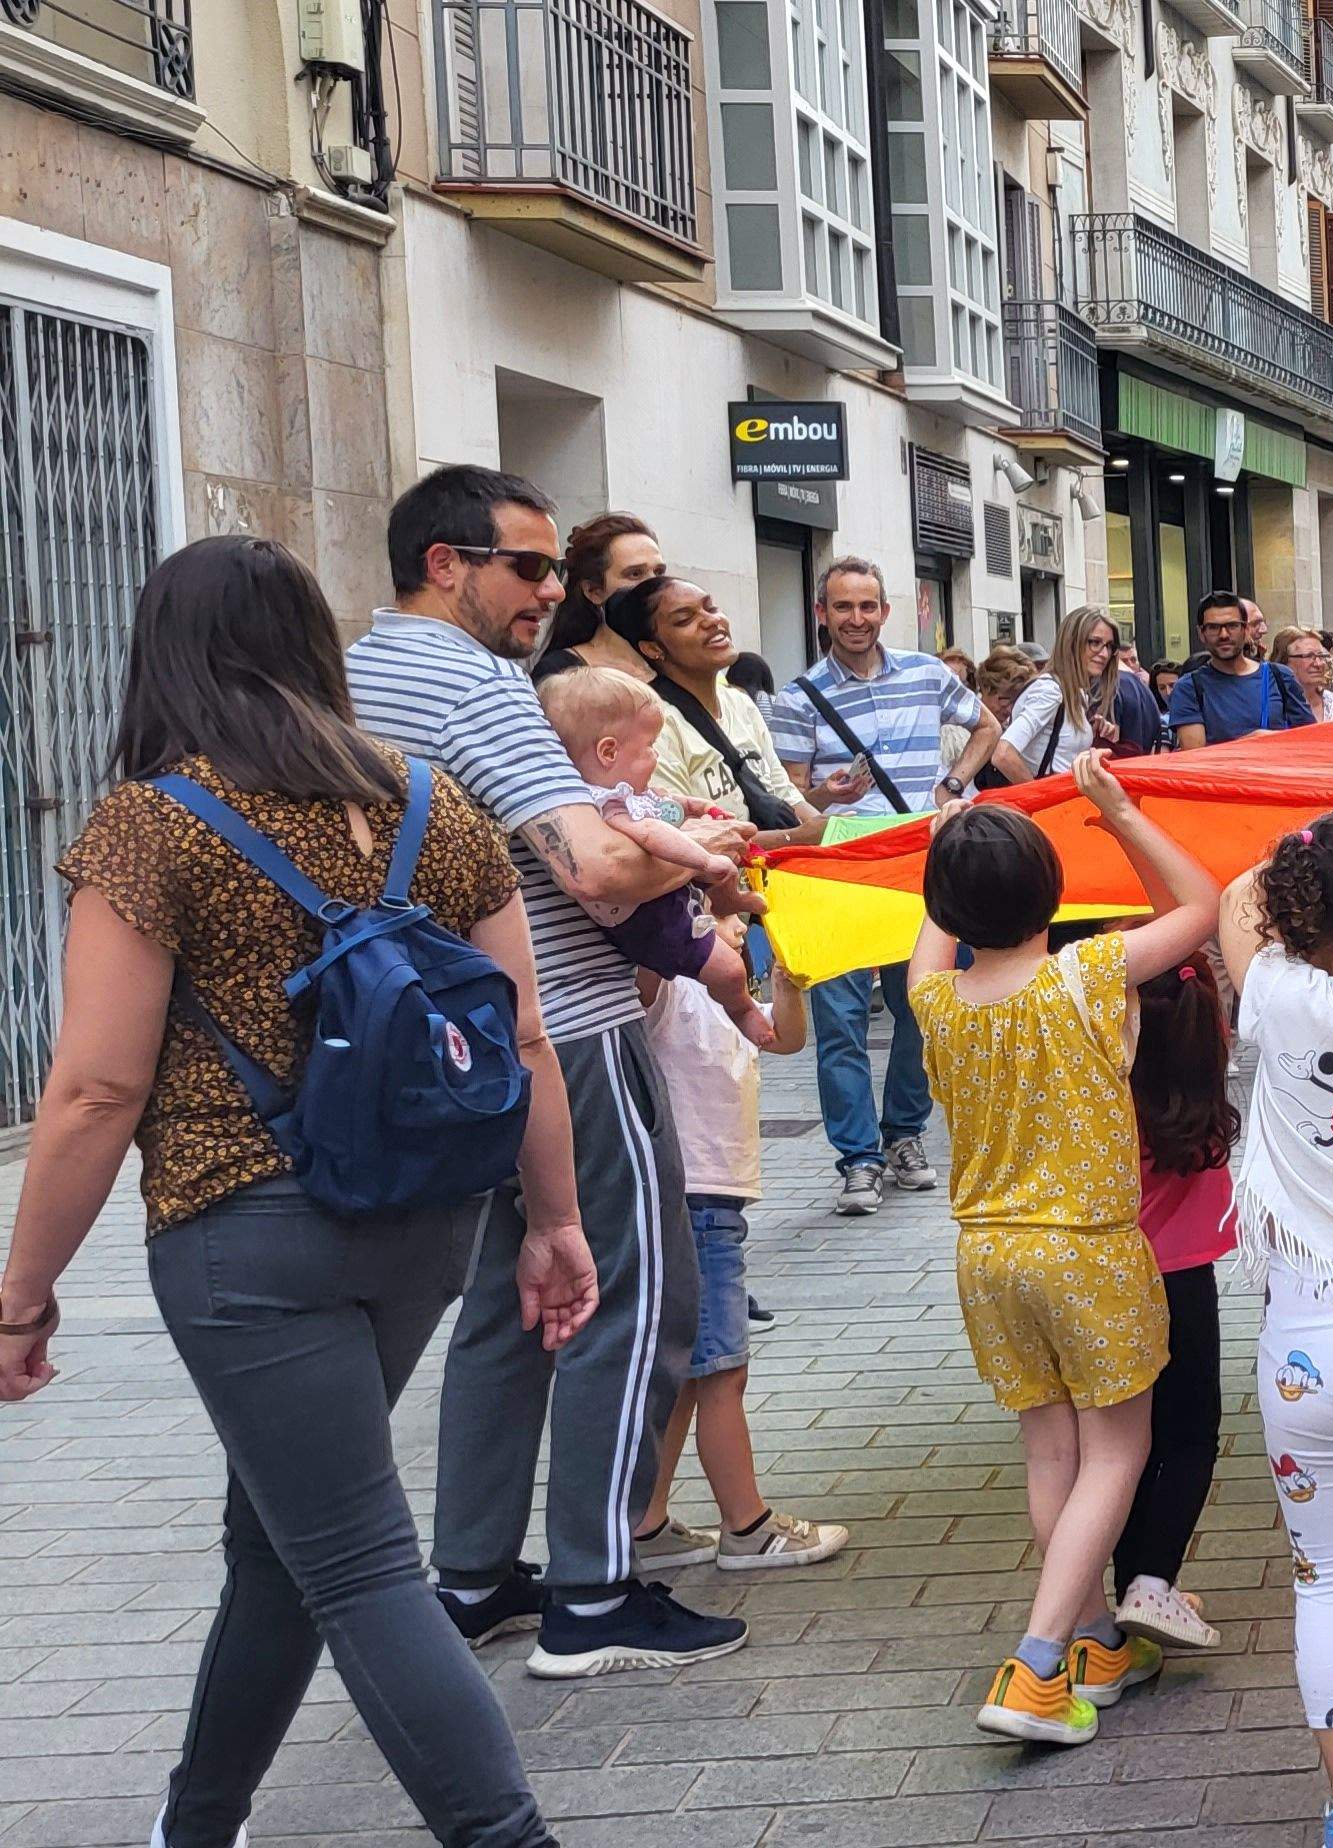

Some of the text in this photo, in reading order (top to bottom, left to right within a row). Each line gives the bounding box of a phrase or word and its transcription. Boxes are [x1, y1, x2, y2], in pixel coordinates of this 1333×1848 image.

[736, 415, 837, 442] embou
[736, 464, 759, 473] FIBRA
[763, 462, 788, 474] MÓVIL
[792, 464, 802, 473] TV
